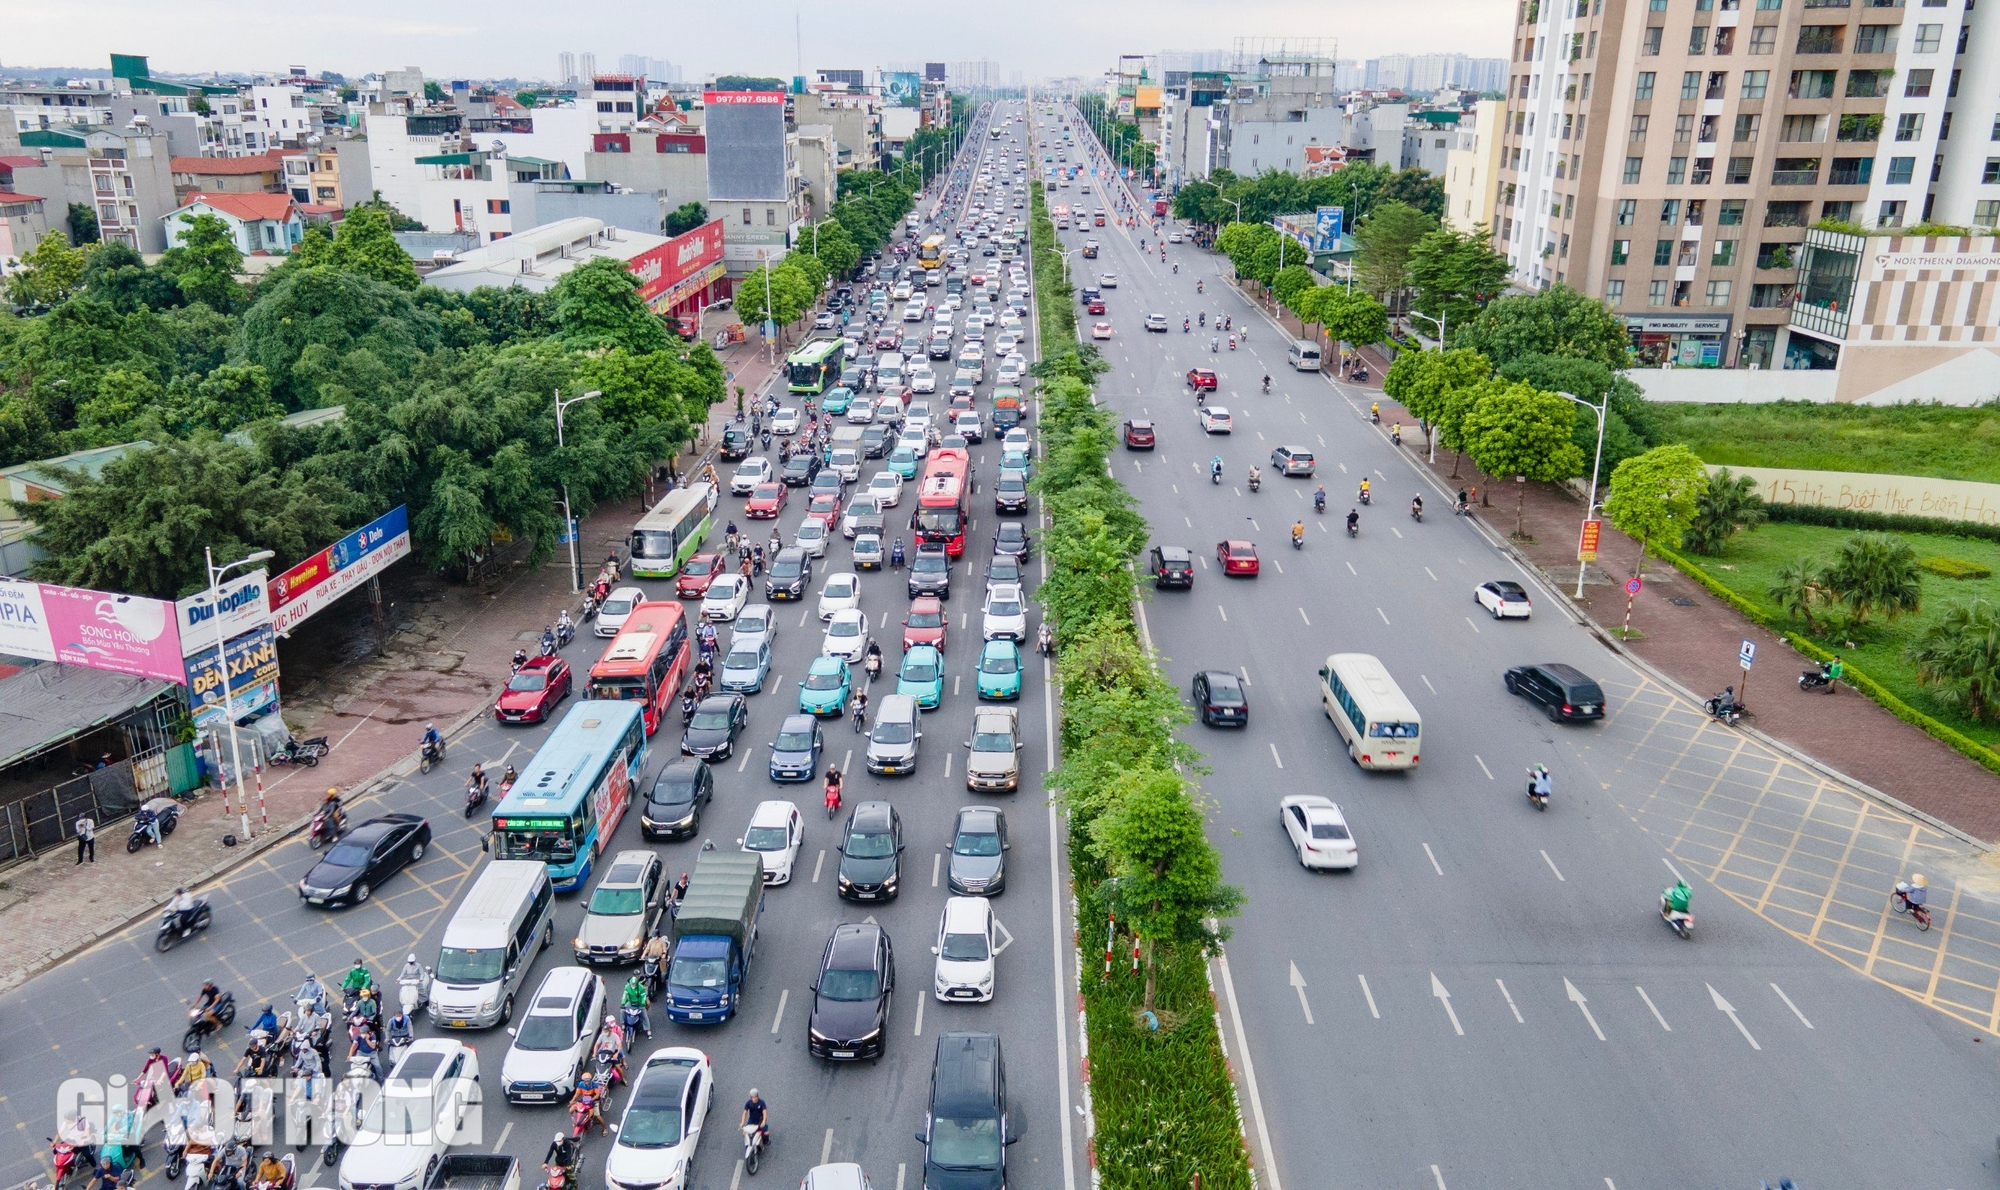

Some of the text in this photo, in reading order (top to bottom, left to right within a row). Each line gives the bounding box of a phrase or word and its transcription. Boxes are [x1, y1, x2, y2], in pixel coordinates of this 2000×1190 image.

[716, 95, 779, 103] 097.997.6886
[1894, 257, 1953, 265] NORTHERN
[368, 527, 383, 543] Delo
[290, 564, 318, 590] Havoline
[329, 579, 337, 590] XE
[0, 602, 37, 624] PIA
[289, 599, 309, 622] HUY
[80, 624, 112, 639] SONG
[254, 661, 277, 678] .com
